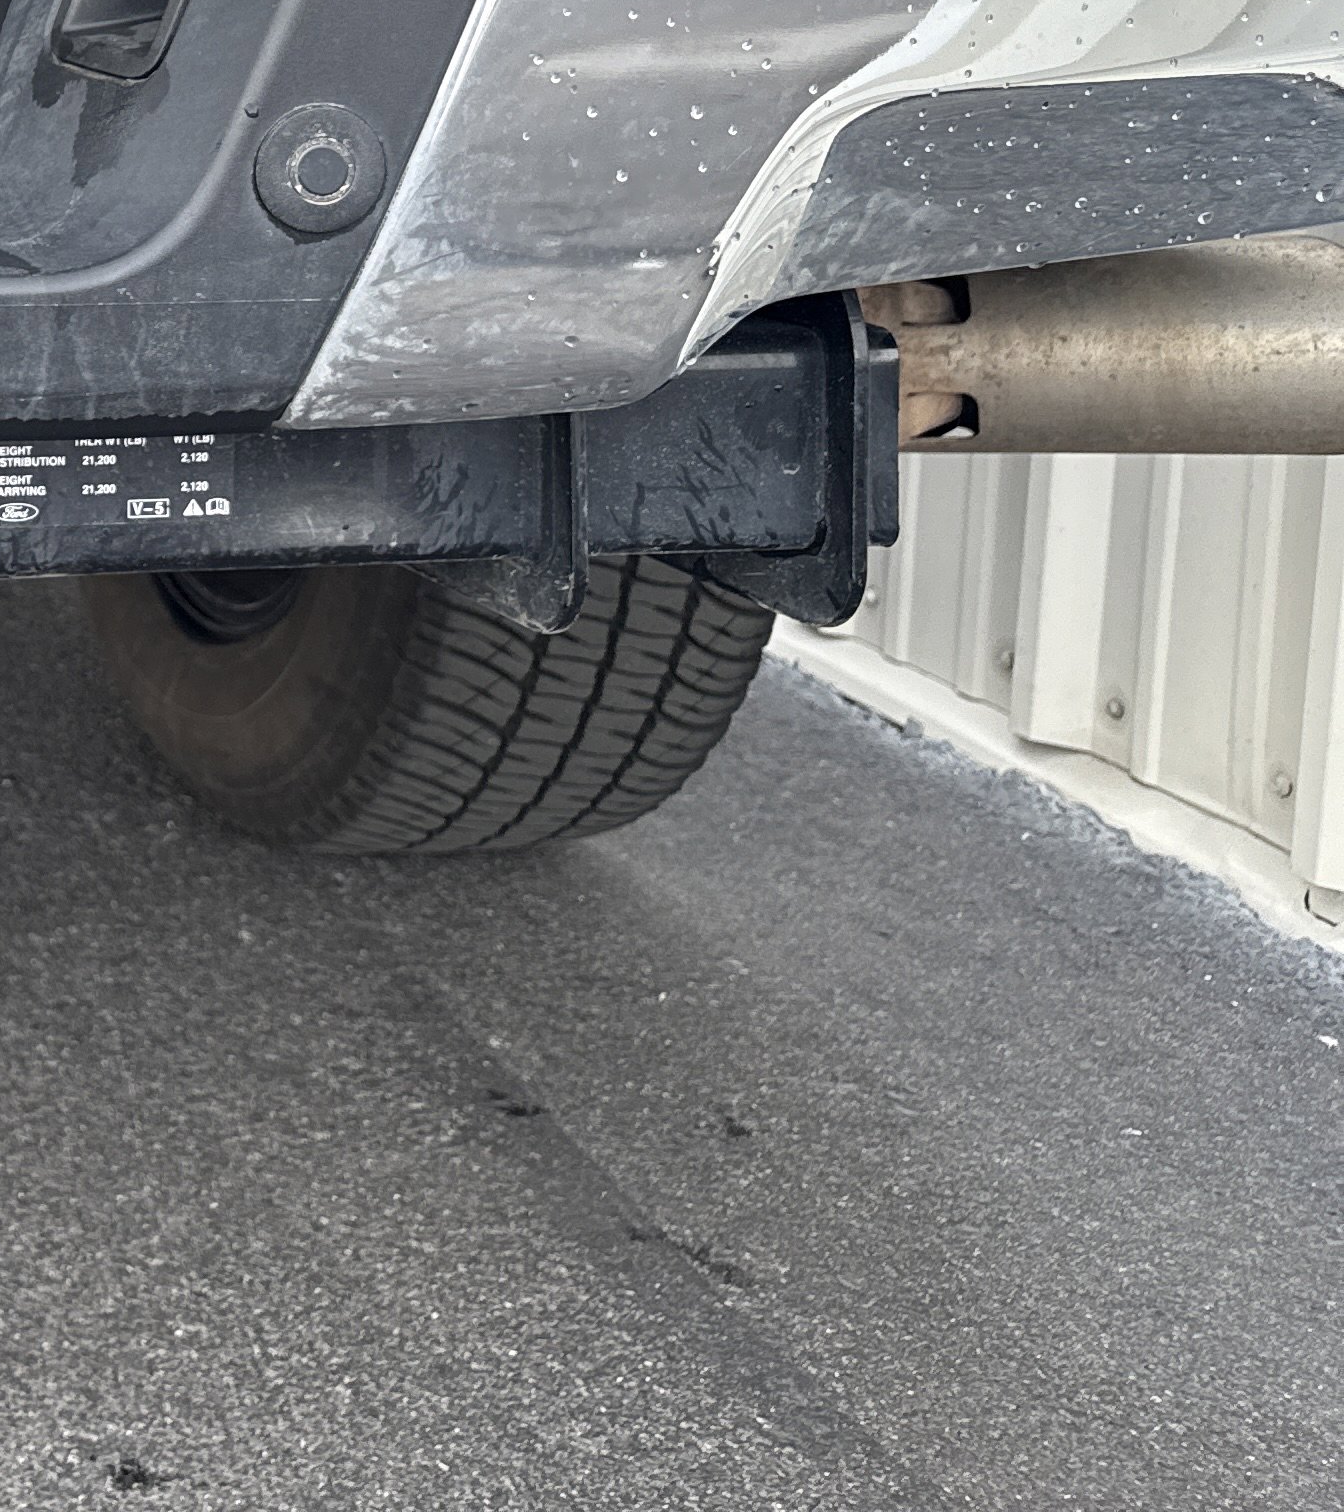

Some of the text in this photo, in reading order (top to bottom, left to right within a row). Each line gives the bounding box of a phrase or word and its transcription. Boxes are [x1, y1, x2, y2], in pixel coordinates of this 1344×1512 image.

[81, 454, 117, 467] 21,200
[180, 451, 209, 464] 2,120
[81, 483, 117, 495] 21,200
[180, 480, 209, 493] 2,120
